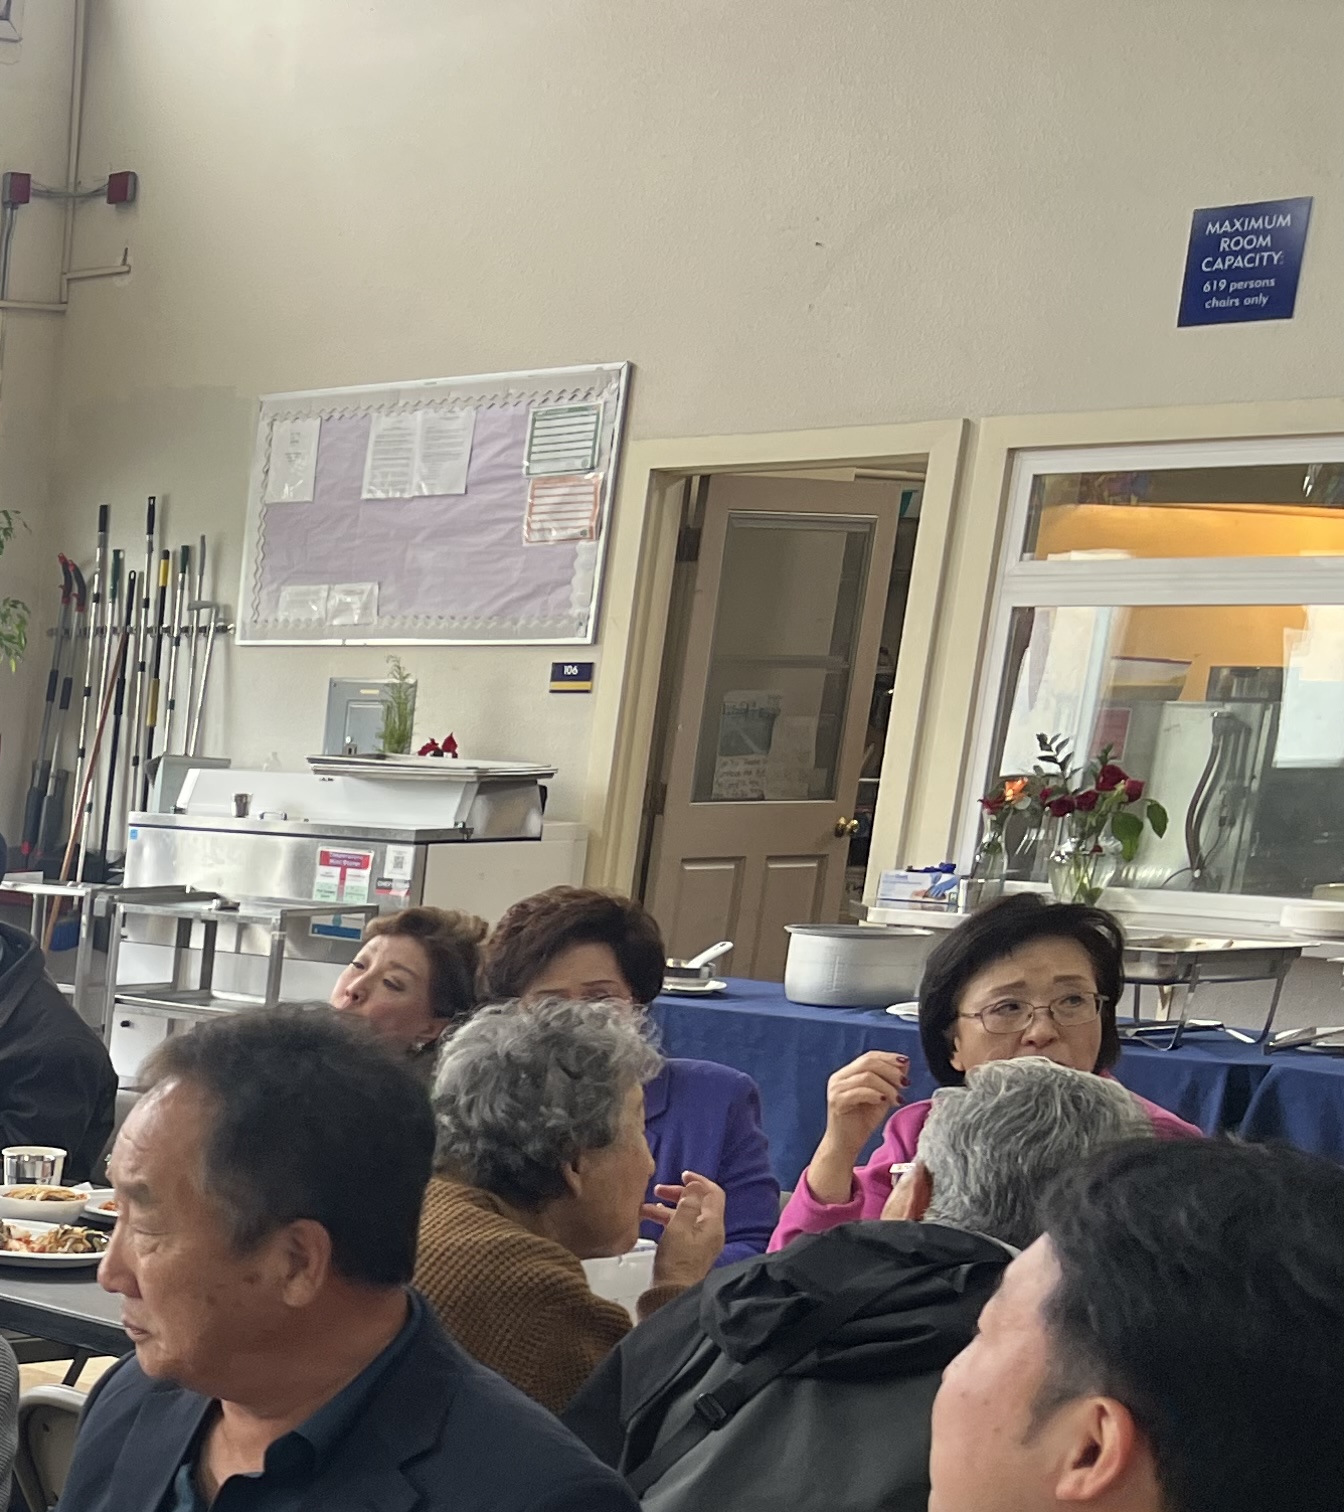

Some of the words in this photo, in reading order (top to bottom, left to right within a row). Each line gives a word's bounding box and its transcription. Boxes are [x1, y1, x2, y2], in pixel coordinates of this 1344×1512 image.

[1205, 213, 1292, 236] MAXIMUM
[1219, 234, 1273, 252] ROOM
[1202, 279, 1227, 293] 619
[1228, 277, 1276, 293] persons
[1204, 296, 1240, 309] chairs
[1243, 292, 1270, 307] only
[563, 665, 579, 675] 106
